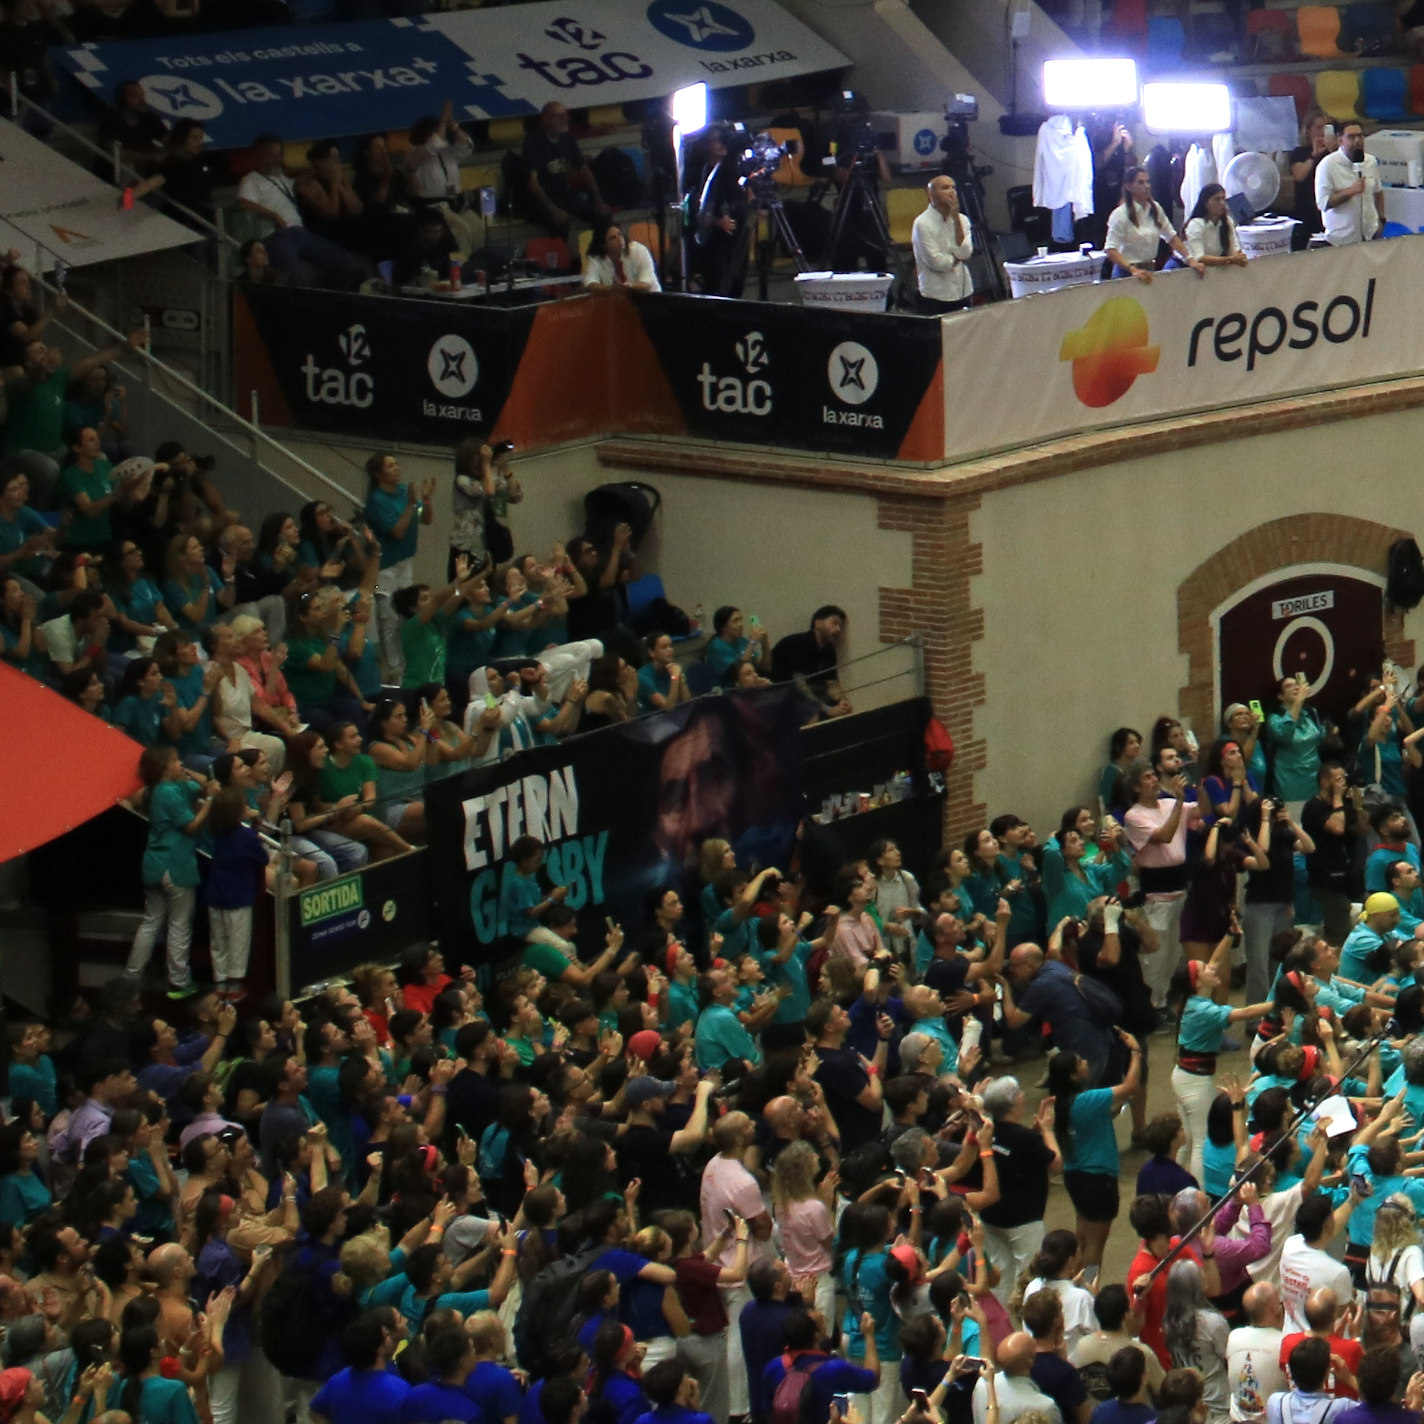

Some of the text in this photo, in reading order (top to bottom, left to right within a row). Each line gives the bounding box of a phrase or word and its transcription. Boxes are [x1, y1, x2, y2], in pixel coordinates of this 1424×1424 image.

[155, 54, 213, 69] Tots
[253, 40, 342, 60] castells
[516, 52, 654, 89] tac
[699, 48, 799, 75] la xarxa
[213, 77, 282, 104] la
[1188, 277, 1376, 371] repsol
[301, 353, 375, 408] tac
[697, 362, 772, 416] tac
[423, 398, 483, 422] la xarxa
[822, 405, 884, 429] la xarxa
[1279, 593, 1328, 617] TORILES
[461, 764, 580, 872] ETERN
[303, 882, 359, 920] SORTIDA
